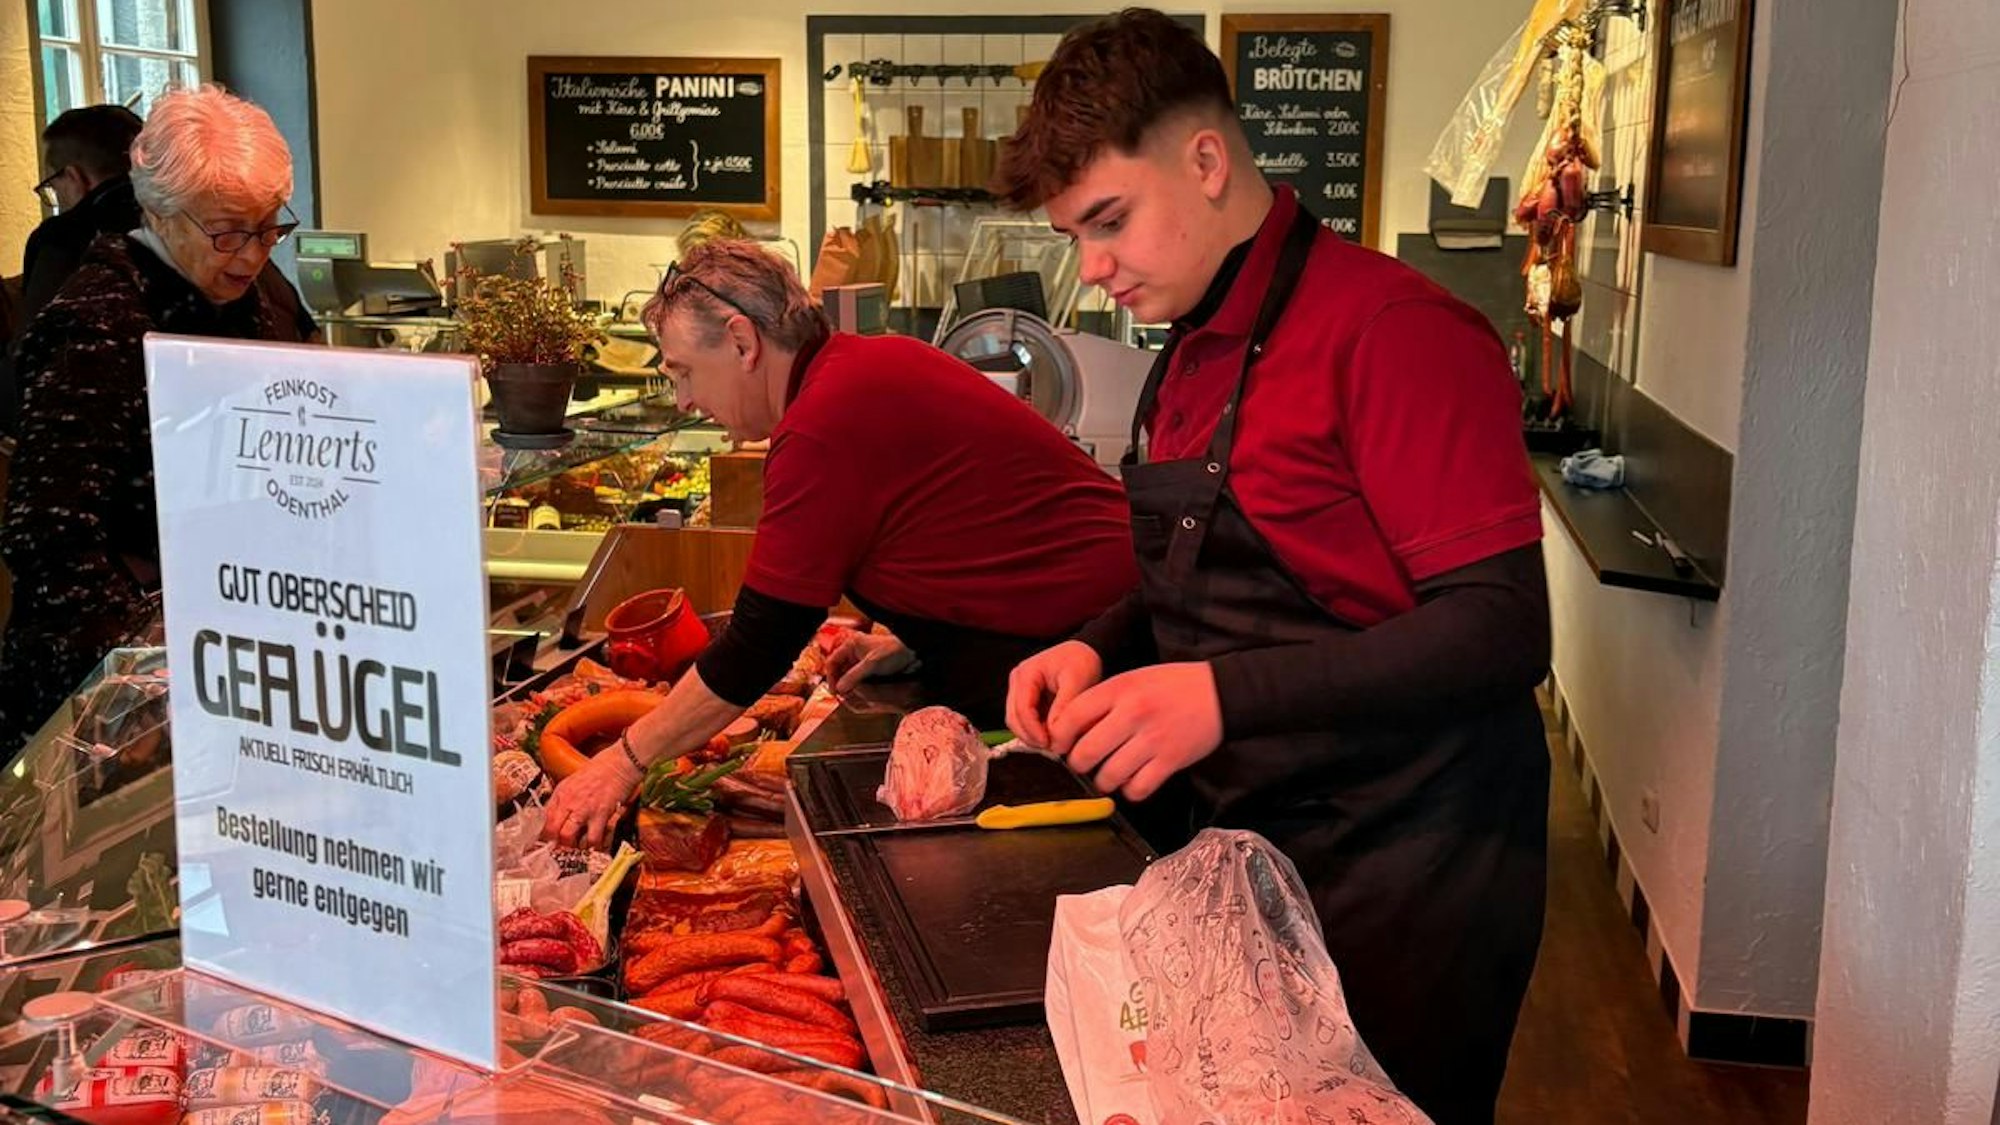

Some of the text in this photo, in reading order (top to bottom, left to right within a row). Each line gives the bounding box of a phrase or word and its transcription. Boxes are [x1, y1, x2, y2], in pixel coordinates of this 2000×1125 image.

[1249, 36, 1317, 64] Belegte
[551, 76, 735, 99] Italienische PANINI
[1254, 64, 1362, 92] BRÖTCHEN
[578, 102, 603, 115] mit
[605, 101, 636, 116] Käse
[639, 102, 650, 116] &
[1278, 103, 1321, 119] Salami
[1263, 121, 1318, 136] Schinken
[595, 140, 638, 154] Salami
[1323, 182, 1357, 199] 4.00€
[264, 379, 338, 409] FEINKOST
[236, 417, 377, 474] Lennerts
[266, 479, 349, 519] ODENTHAL
[218, 563, 417, 632] GUT OBERSCHEID
[192, 621, 462, 768] GEFLÜGEL
[239, 736, 414, 795] AKTUELL FRISCH ERHÄLTLICH
[217, 805, 318, 865] Bestellung
[323, 832, 406, 886] nehmen
[411, 859, 446, 897] wir
[253, 865, 410, 938] gerne entgegen
